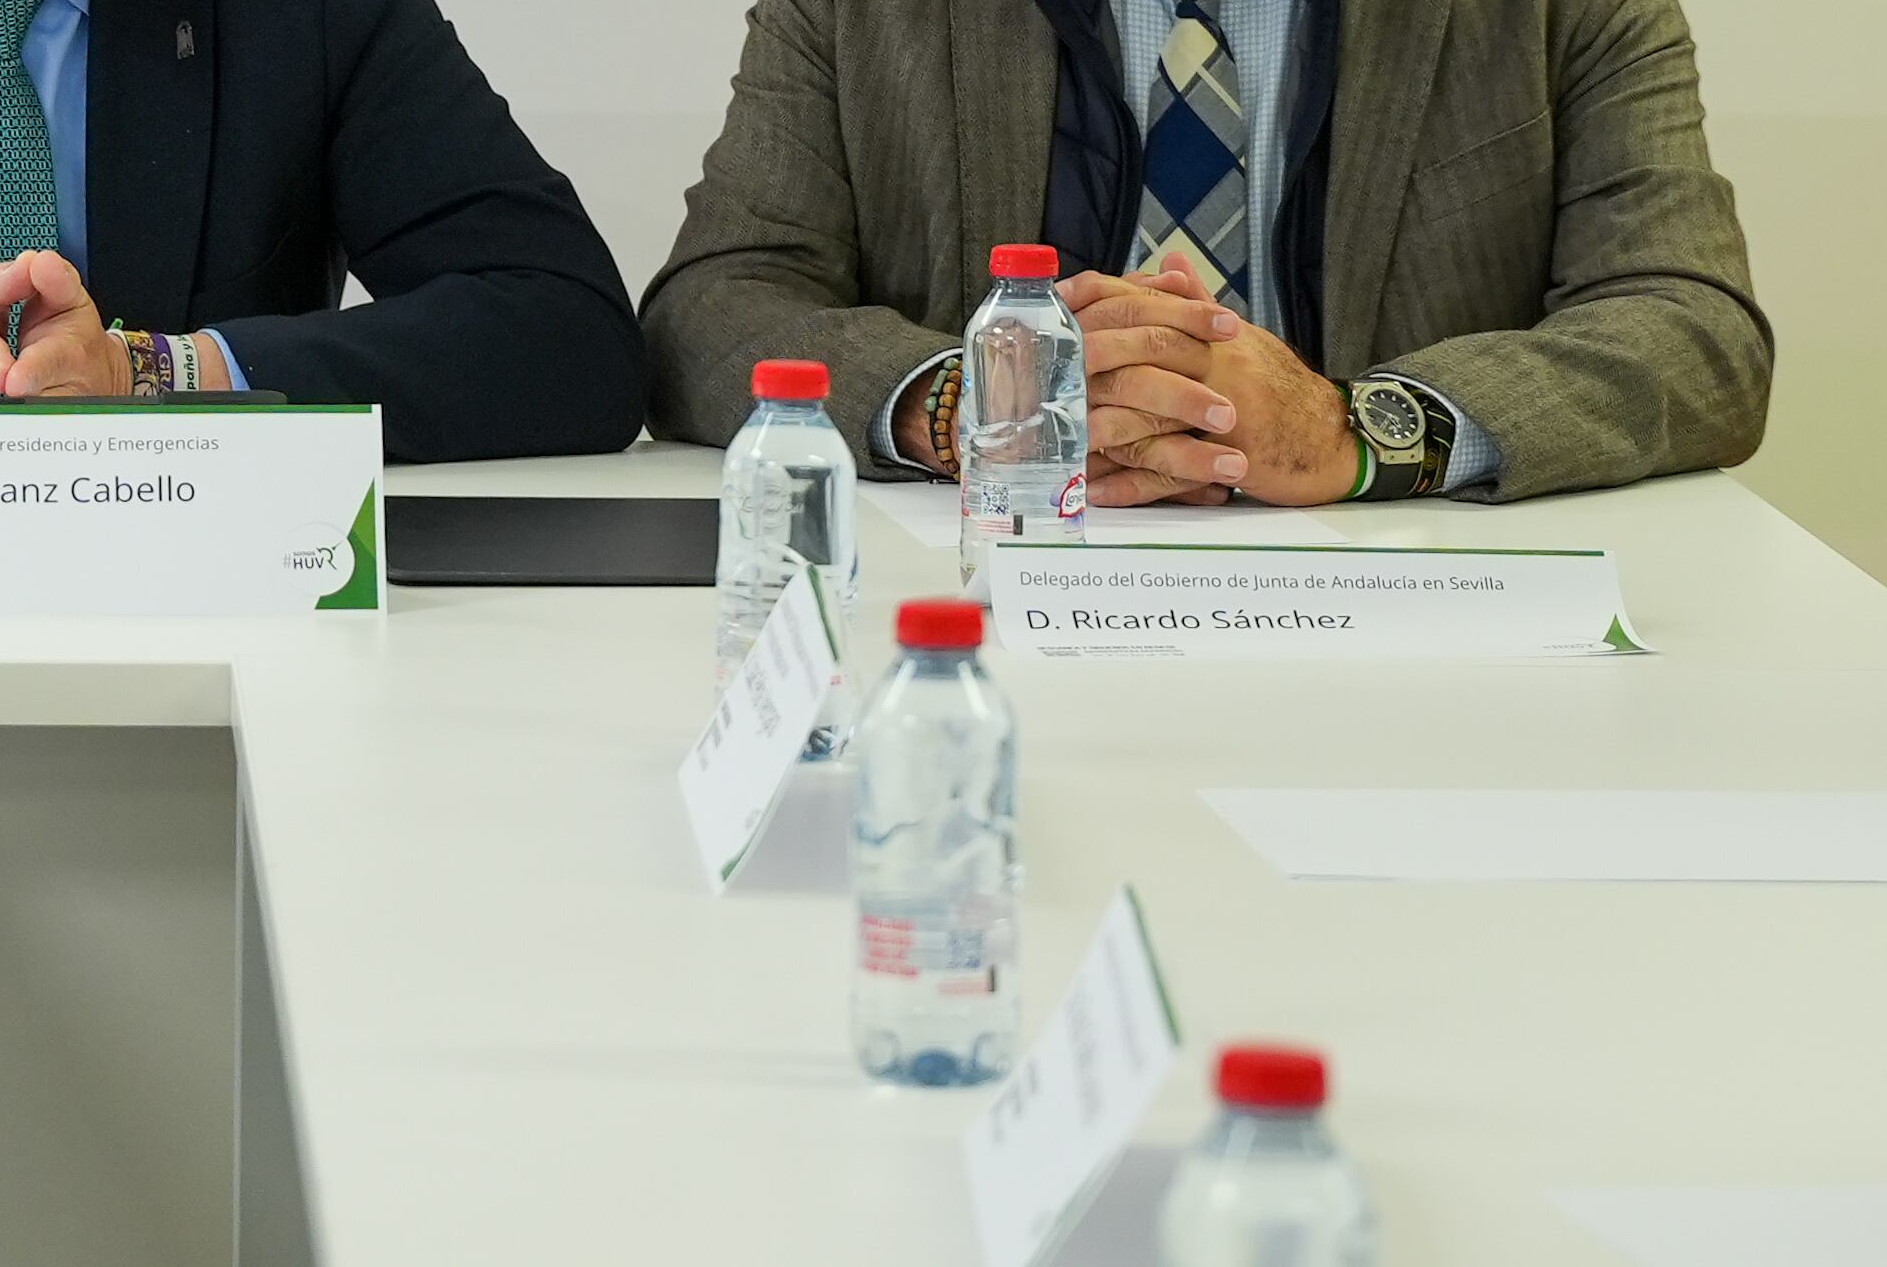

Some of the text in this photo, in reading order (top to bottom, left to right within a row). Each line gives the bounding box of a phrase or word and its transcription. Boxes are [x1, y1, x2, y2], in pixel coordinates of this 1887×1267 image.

[92, 440, 103, 456] y
[107, 435, 220, 456] Emergencias
[70, 474, 196, 504] Cabello
[1019, 570, 1505, 592] Delegado del Gobierno de Junta de Andalucía en Sevilla
[1026, 608, 1355, 630] D. Ricardo Sánchez
